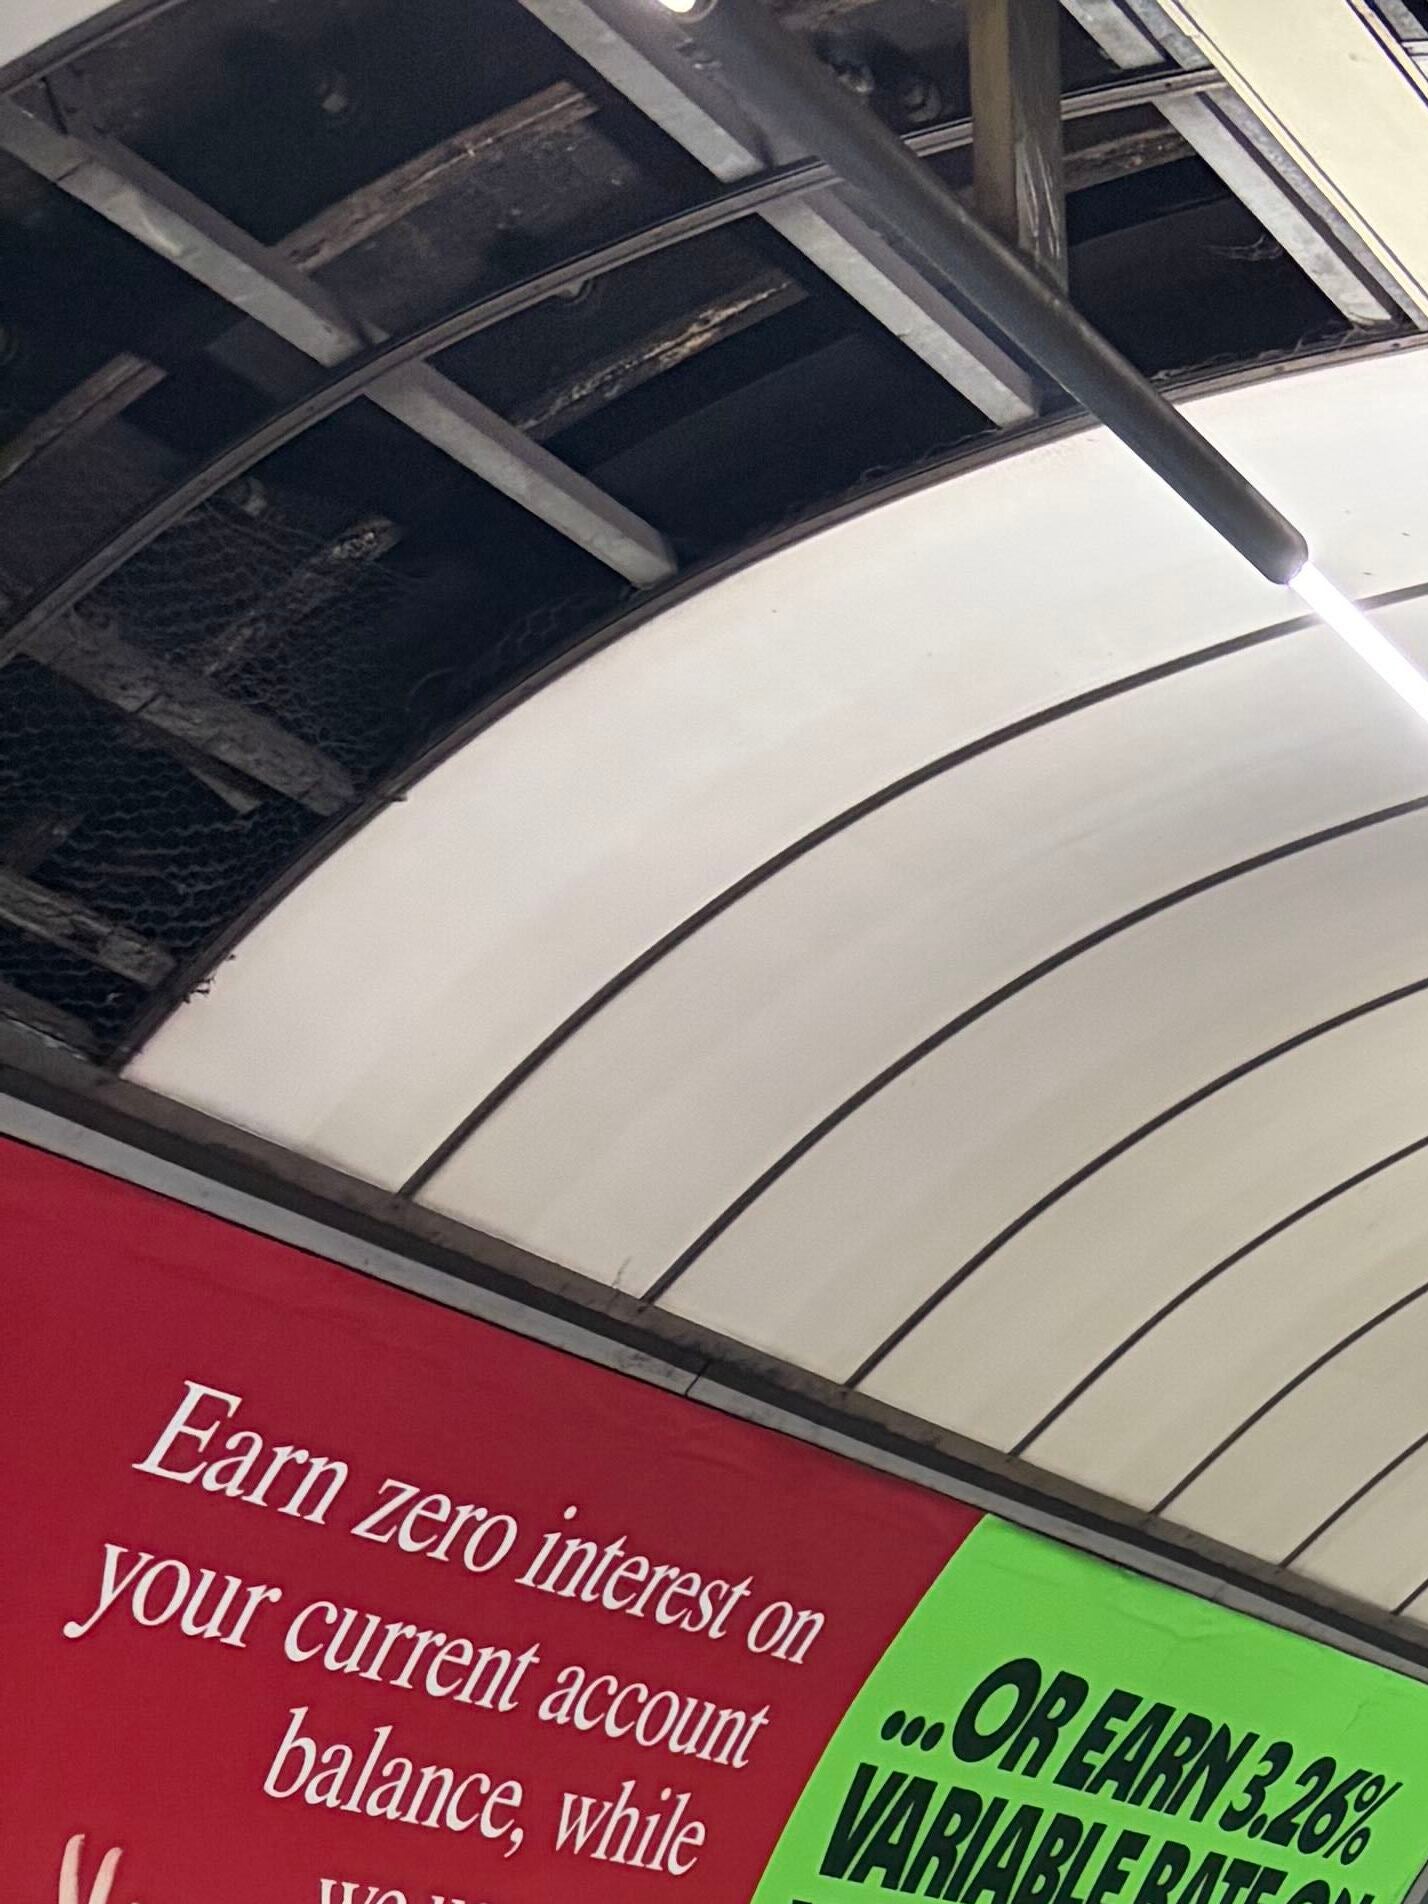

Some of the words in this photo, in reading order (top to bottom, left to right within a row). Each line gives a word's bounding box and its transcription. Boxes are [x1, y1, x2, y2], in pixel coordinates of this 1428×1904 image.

[132, 1381, 349, 1524] Earn
[352, 1479, 518, 1573] zero
[515, 1505, 754, 1639] interest
[747, 1601, 825, 1664] on
[64, 1543, 281, 1648] your
[284, 1601, 539, 1711] current
[539, 1665, 770, 1769] account
[881, 1657, 1089, 1778] ...OR
[1053, 1688, 1258, 1823] EARN
[1218, 1741, 1403, 1865] 3.26%
[264, 1707, 525, 1858] balance,
[555, 1781, 706, 1876] while
